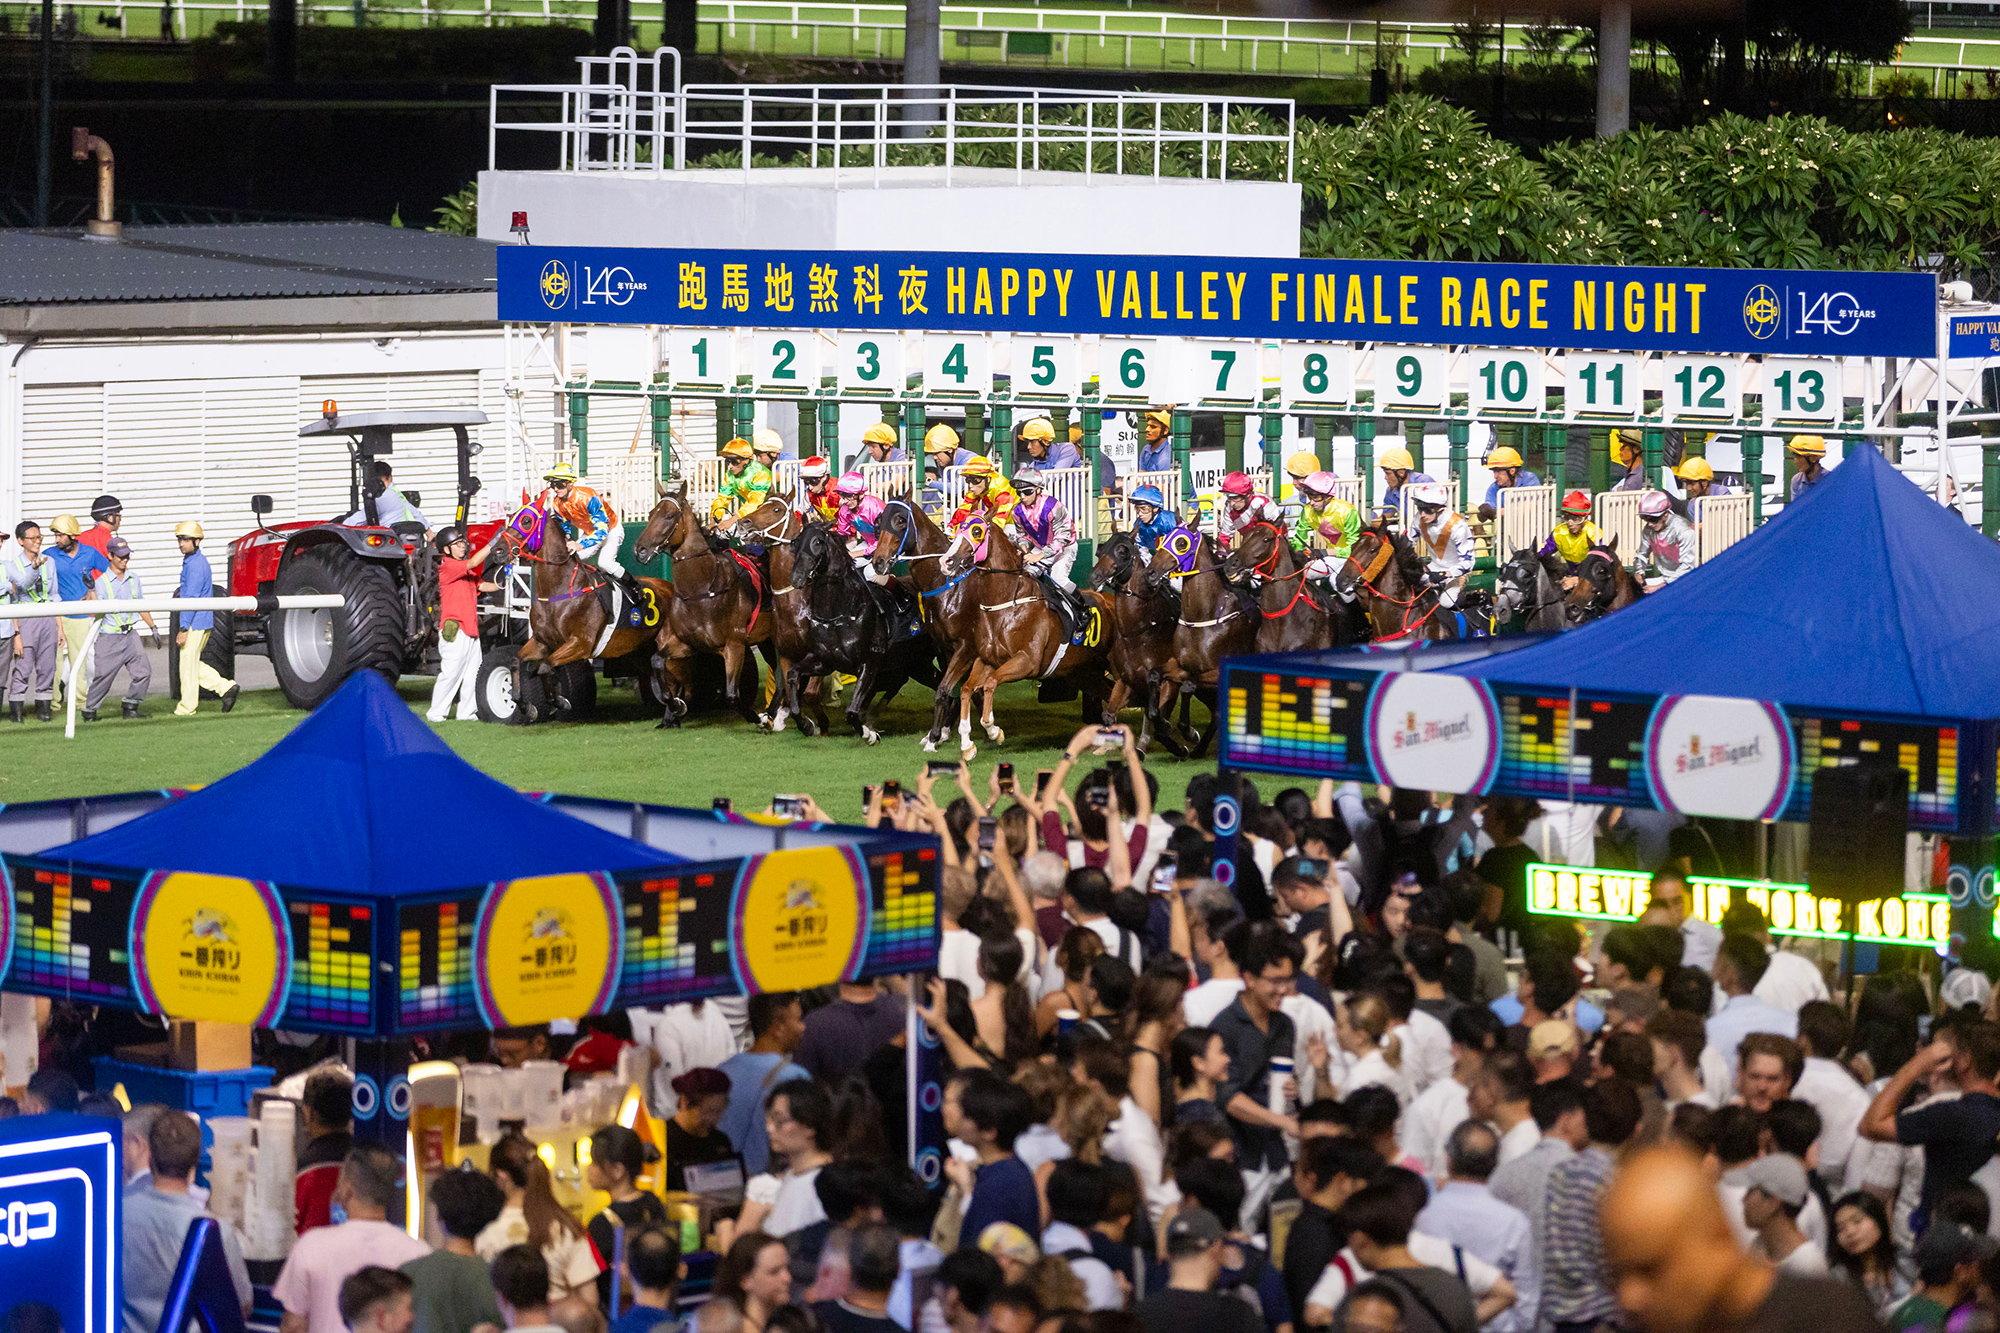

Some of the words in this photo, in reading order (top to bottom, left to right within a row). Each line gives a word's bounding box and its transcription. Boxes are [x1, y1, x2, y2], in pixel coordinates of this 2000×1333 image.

[582, 266, 635, 306] 140
[624, 282, 648, 291] YEARS
[678, 261, 929, 315] 跑馬地煞科夜
[947, 267, 1073, 317] HAPPY
[1096, 270, 1247, 321] VALLEY
[1271, 272, 1419, 325] FINALE
[1441, 276, 1548, 329] RACE
[1573, 280, 1706, 334] NIGHT
[1795, 291, 1860, 336] 140
[1848, 309, 1876, 318] YEARS
[1956, 322, 1985, 335] HAPPY
[692, 338, 707, 377] 1
[772, 340, 796, 379] 2
[856, 341, 880, 381] 3
[942, 343, 969, 383] 4
[1030, 346, 1056, 386] 5
[1119, 348, 1146, 388] 6
[1211, 350, 1236, 391] 7
[1303, 353, 1329, 394] 8
[1396, 356, 1422, 397] 9
[1480, 360, 1528, 402] 10
[1579, 363, 1623, 405] 11
[1674, 366, 1725, 408] 12
[1774, 369, 1824, 412] 13
[1103, 443, 1135, 457] 聖約翰
[1118, 431, 1128, 441] St
[642, 587, 660, 627] 3
[1533, 869, 1652, 918] BREWE
